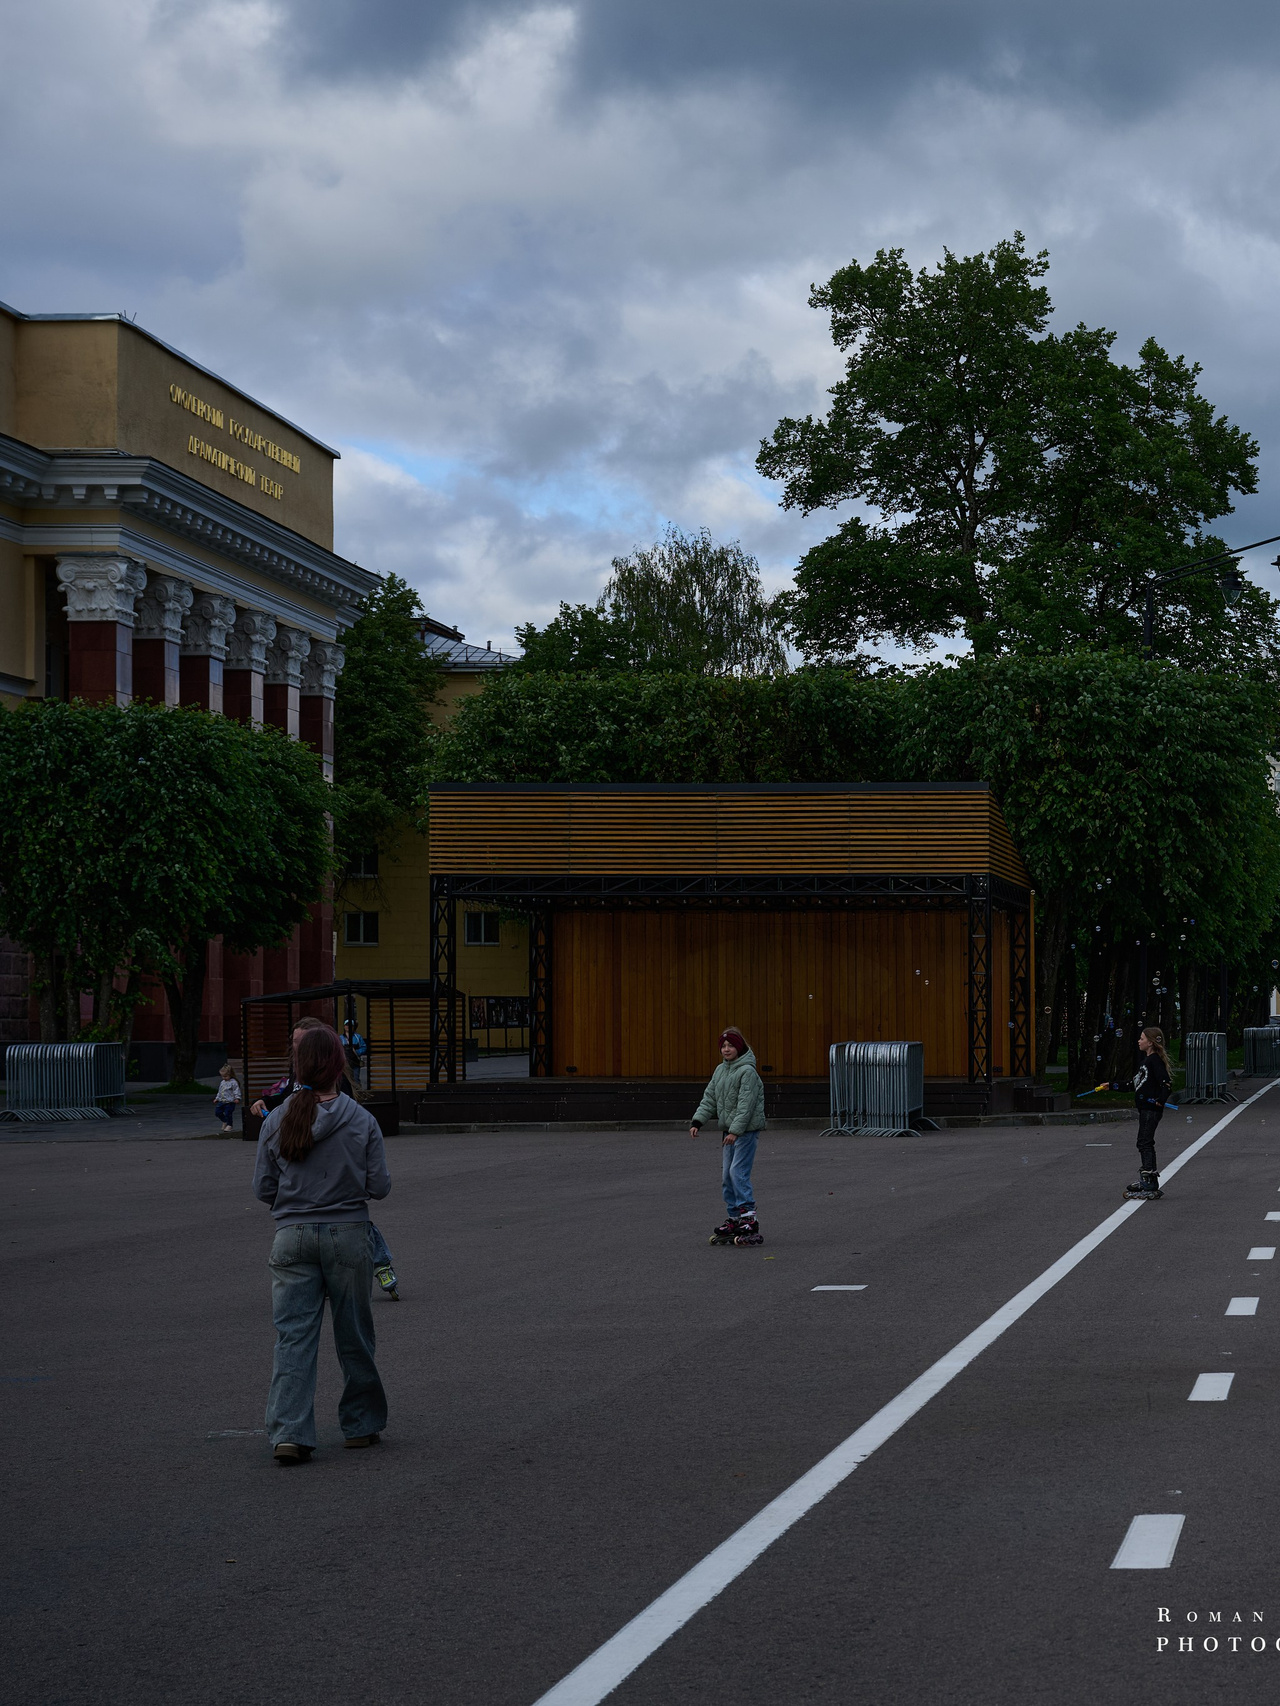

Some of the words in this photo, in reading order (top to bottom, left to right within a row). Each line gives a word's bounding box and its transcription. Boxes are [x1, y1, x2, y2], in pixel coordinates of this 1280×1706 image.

[169, 383, 224, 430] СМОЛЕНСКИЙ
[229, 418, 300, 474] ГОСУДАРСТВЕННЫЙ
[188, 435, 256, 487] ДРАМАТИЧЕСКИЙ
[260, 474, 284, 500] ТЕАТР
